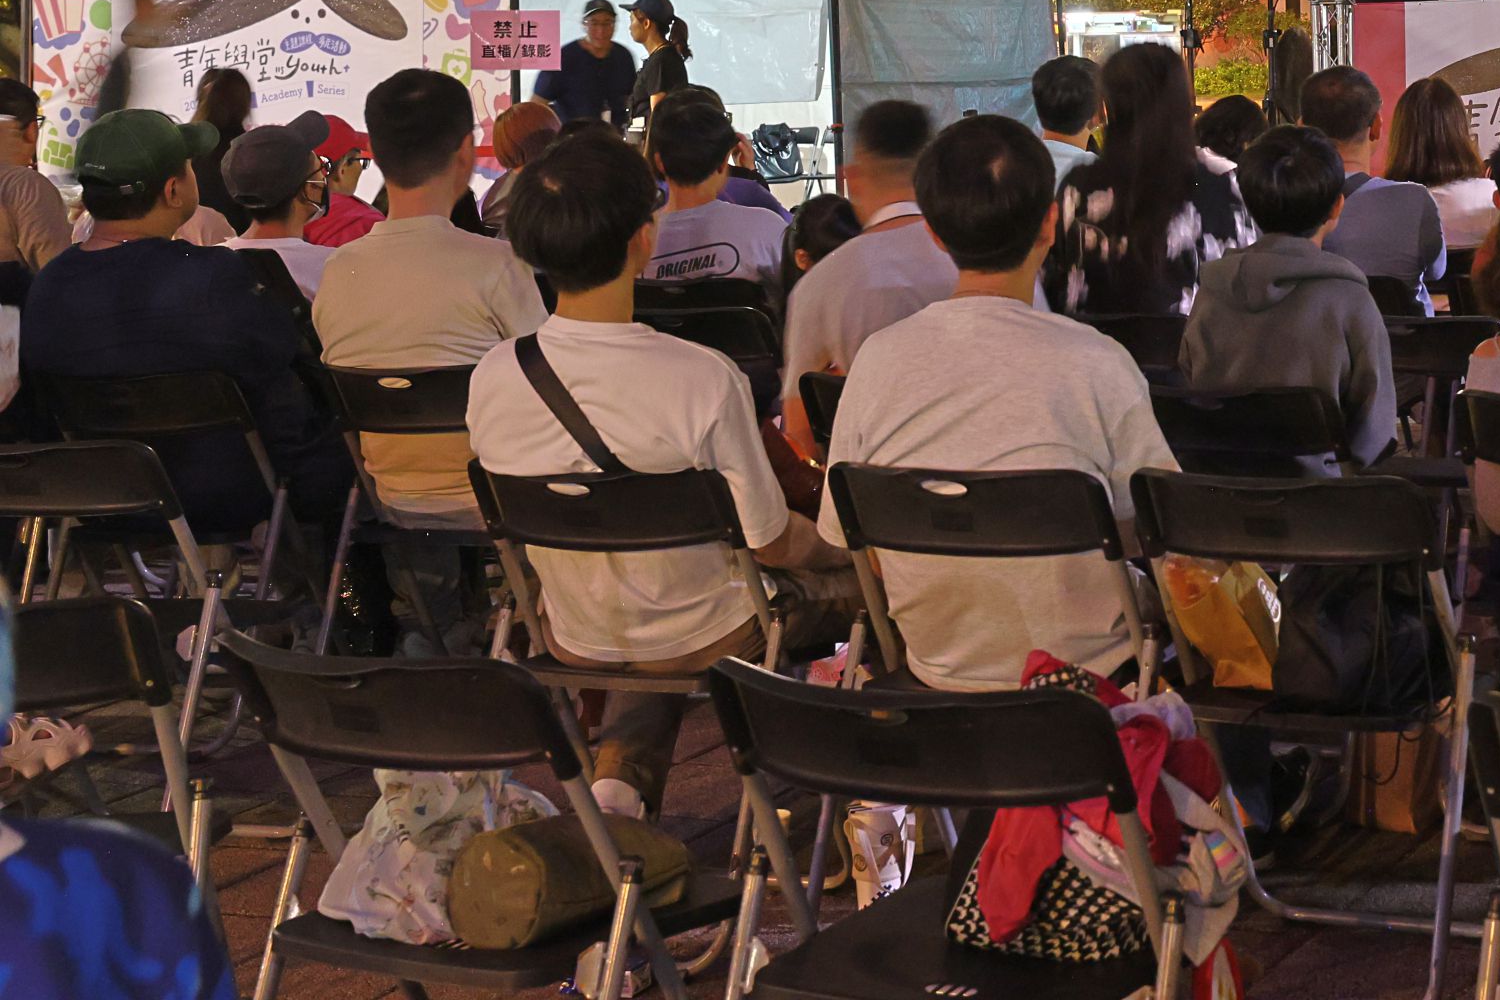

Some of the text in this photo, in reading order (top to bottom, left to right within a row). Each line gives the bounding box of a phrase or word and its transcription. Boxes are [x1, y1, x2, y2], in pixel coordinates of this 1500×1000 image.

[493, 20, 537, 39] 禁止
[481, 43, 552, 59] 直播/錄影
[260, 87, 303, 104] Academy
[317, 84, 346, 96] Series
[656, 253, 717, 280] ORIGINAL
